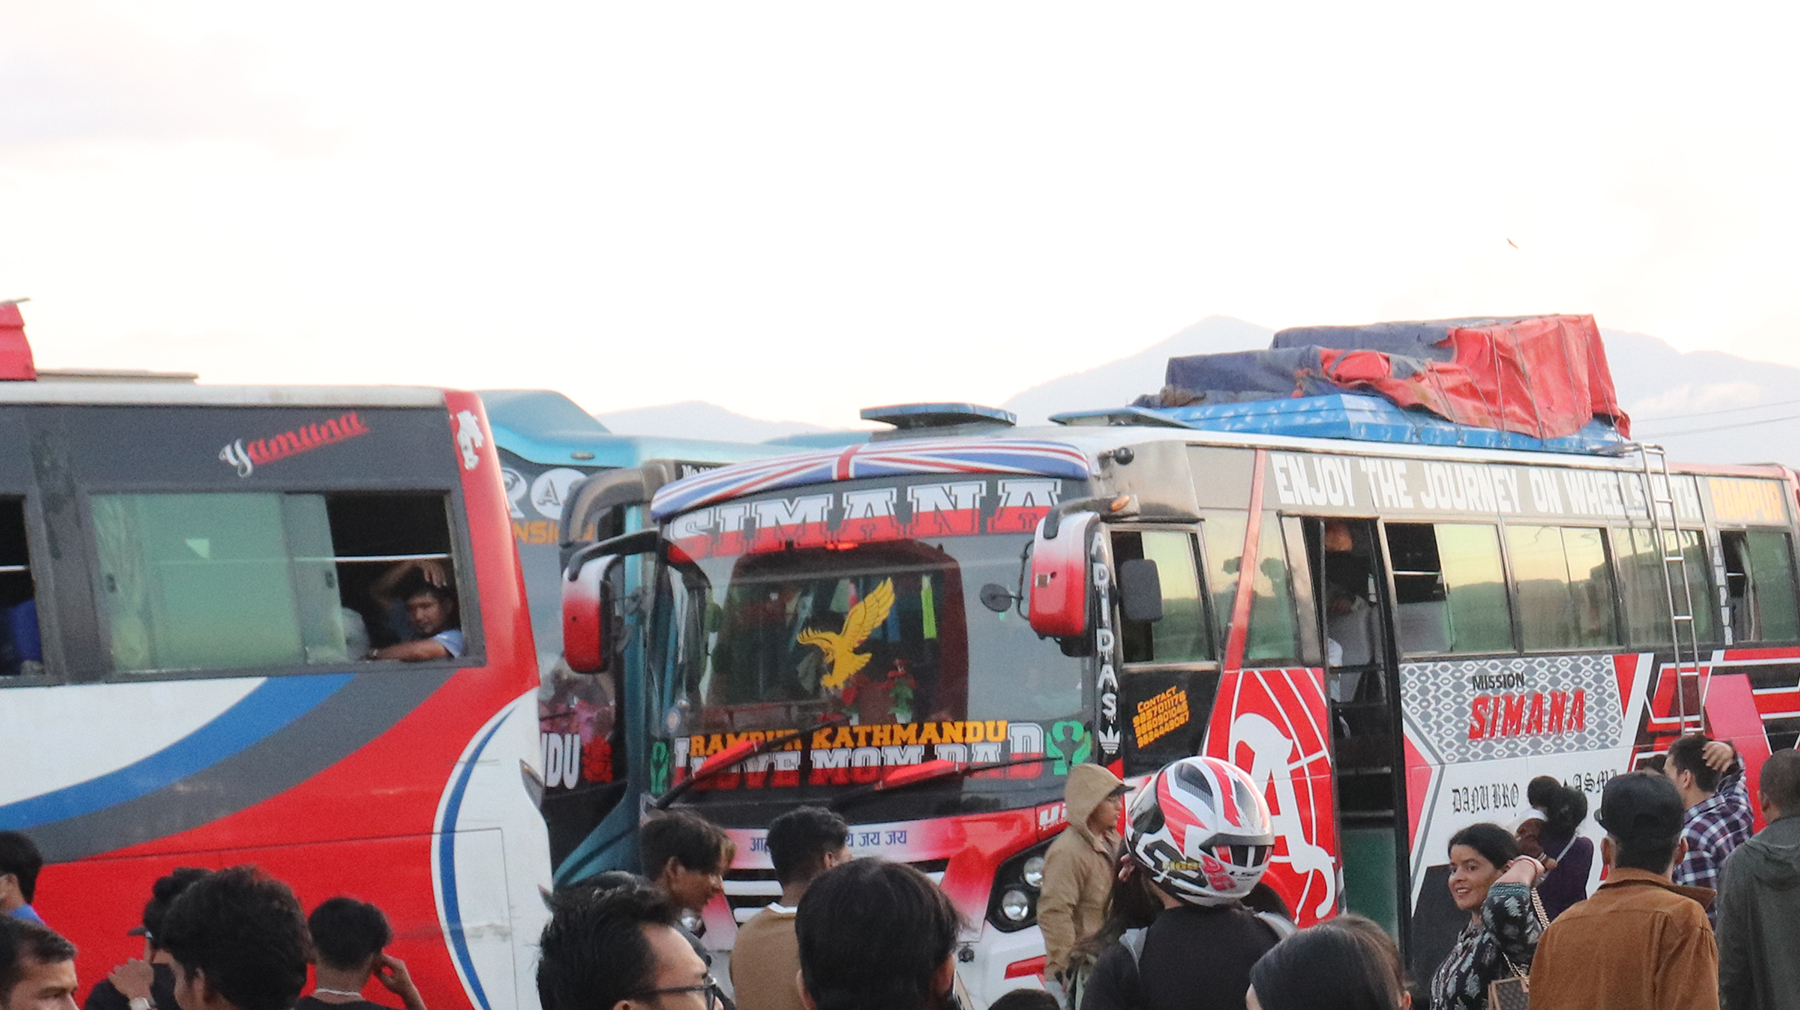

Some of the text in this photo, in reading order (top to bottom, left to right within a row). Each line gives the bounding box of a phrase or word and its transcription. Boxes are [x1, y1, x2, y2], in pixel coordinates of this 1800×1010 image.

[1270, 453, 1355, 507] ENJOY
[1359, 457, 1414, 508] THE
[1420, 462, 1522, 513] JOURNEY
[1529, 468, 1564, 514] ON
[1709, 478, 1785, 521] RAMPUR
[667, 478, 1061, 563] SIMANA
[1472, 672, 1525, 691] MISSION
[811, 720, 1008, 750] KATHMANDU
[1468, 689, 1586, 741] SIMANA
[542, 732, 581, 789] DU
[809, 744, 925, 786] MOM
